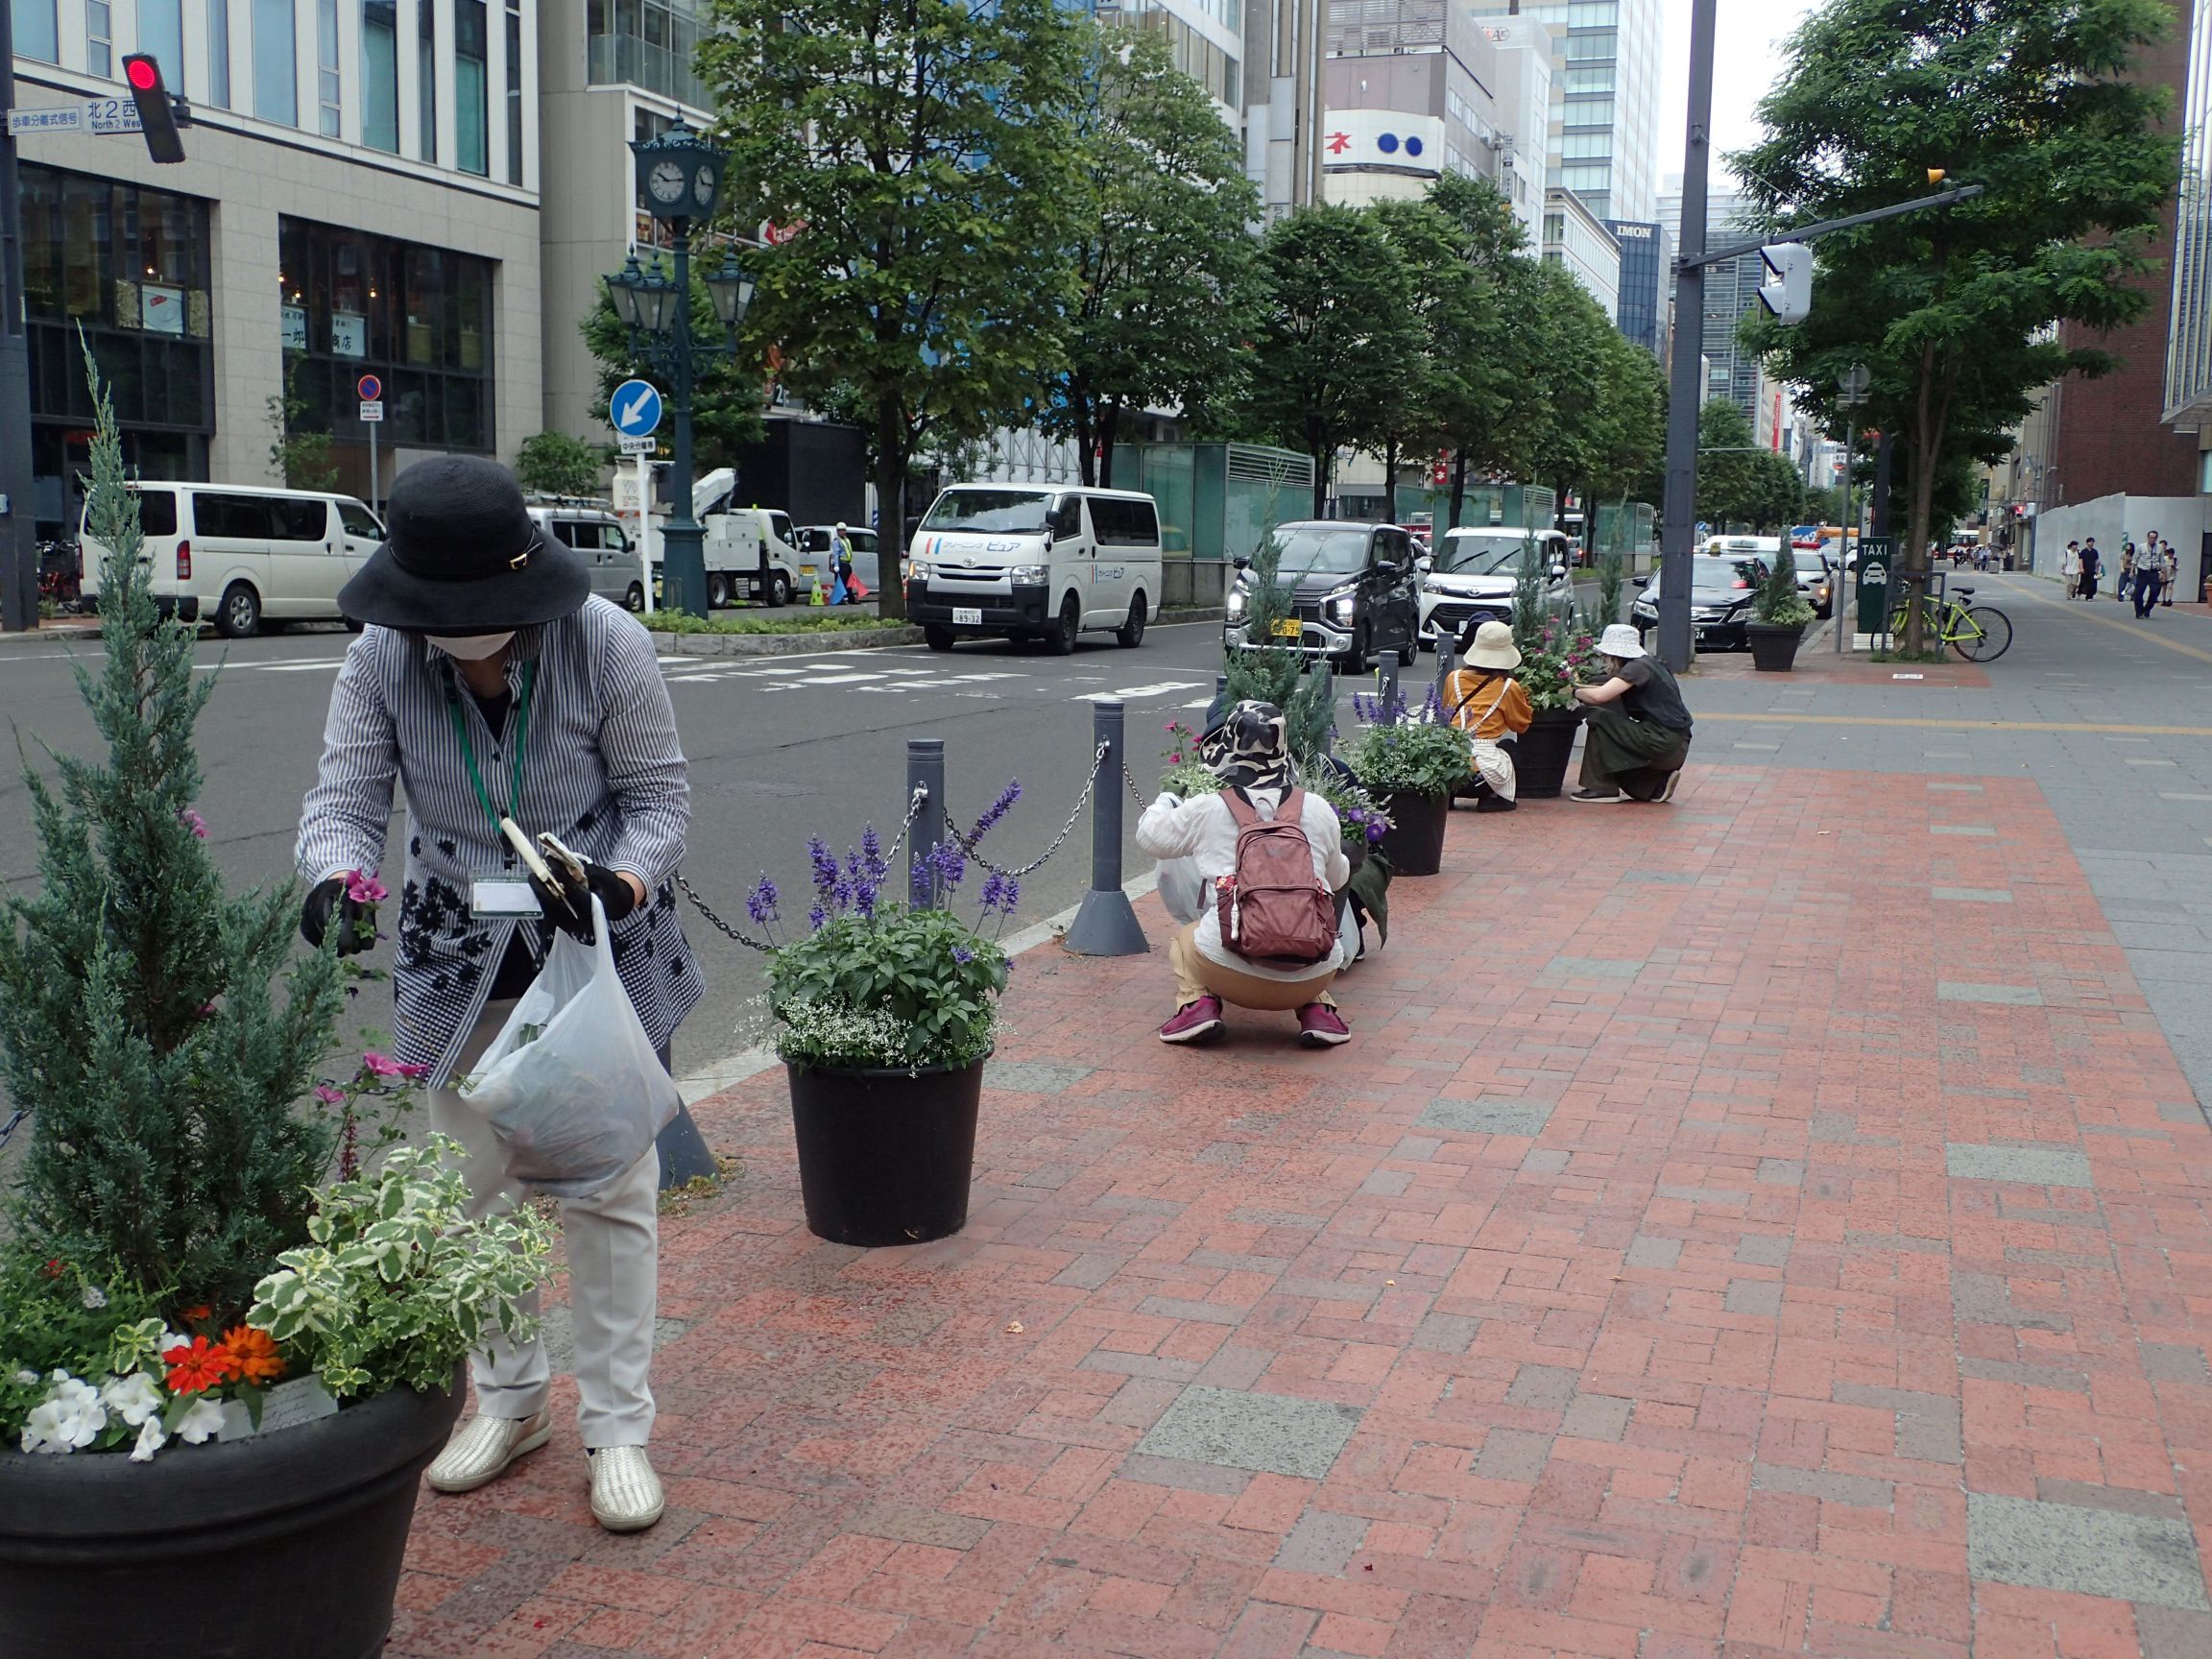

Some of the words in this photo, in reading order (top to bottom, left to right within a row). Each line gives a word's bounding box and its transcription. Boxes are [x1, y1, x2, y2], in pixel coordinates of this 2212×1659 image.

[12, 112, 77, 128] 歩車分離式信号
[91, 119, 113, 130] North
[114, 118, 121, 129] 2
[123, 117, 141, 128] Wes
[1616, 225, 1652, 238] IMON
[986, 541, 1022, 553] ピュア
[1863, 544, 1887, 556] TAXI
